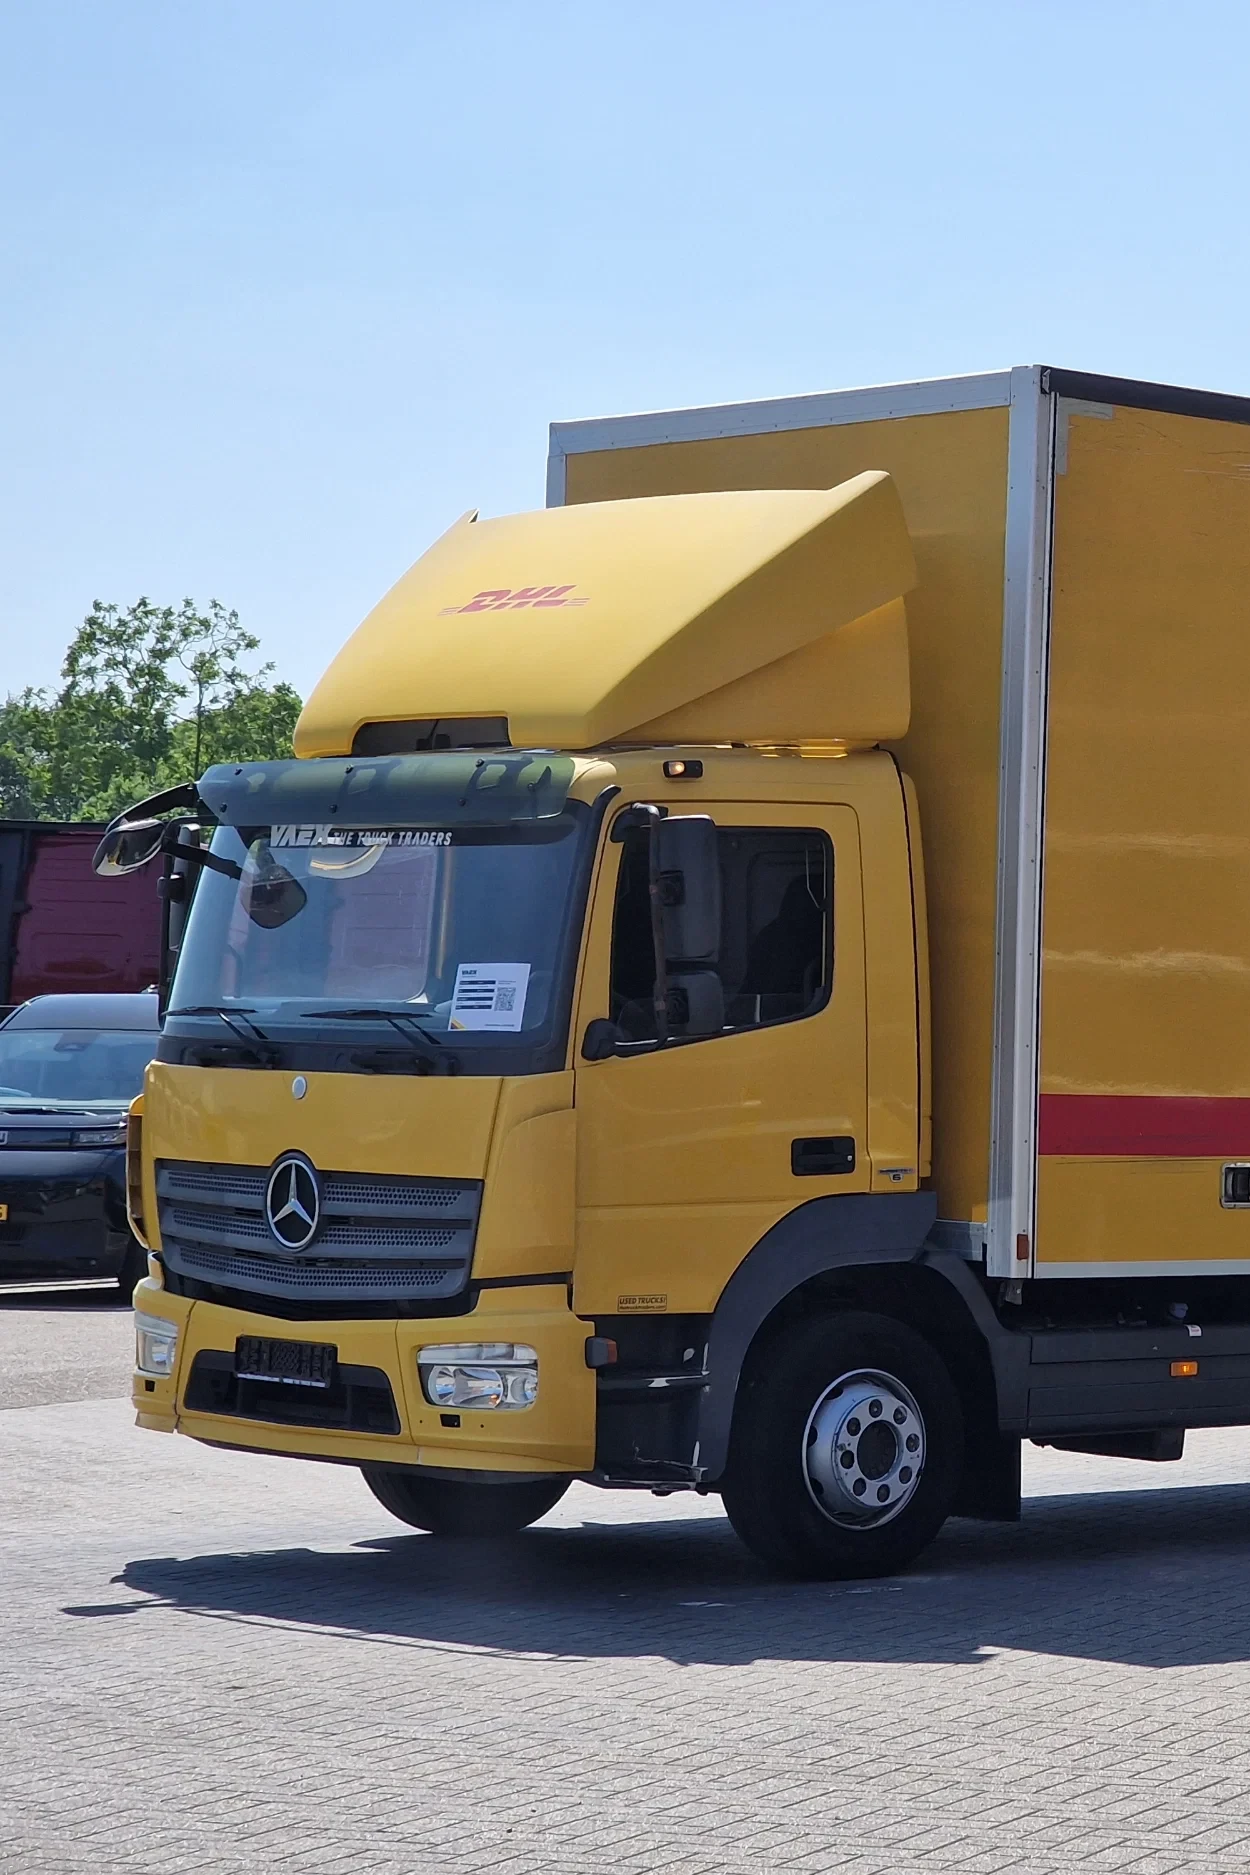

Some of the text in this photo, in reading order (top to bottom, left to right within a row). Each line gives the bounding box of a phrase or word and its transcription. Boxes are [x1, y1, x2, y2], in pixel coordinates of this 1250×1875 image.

[457, 585, 577, 613] DHL
[270, 823, 333, 847] VAEX
[332, 831, 354, 846] THE
[398, 831, 453, 846] TRADERS
